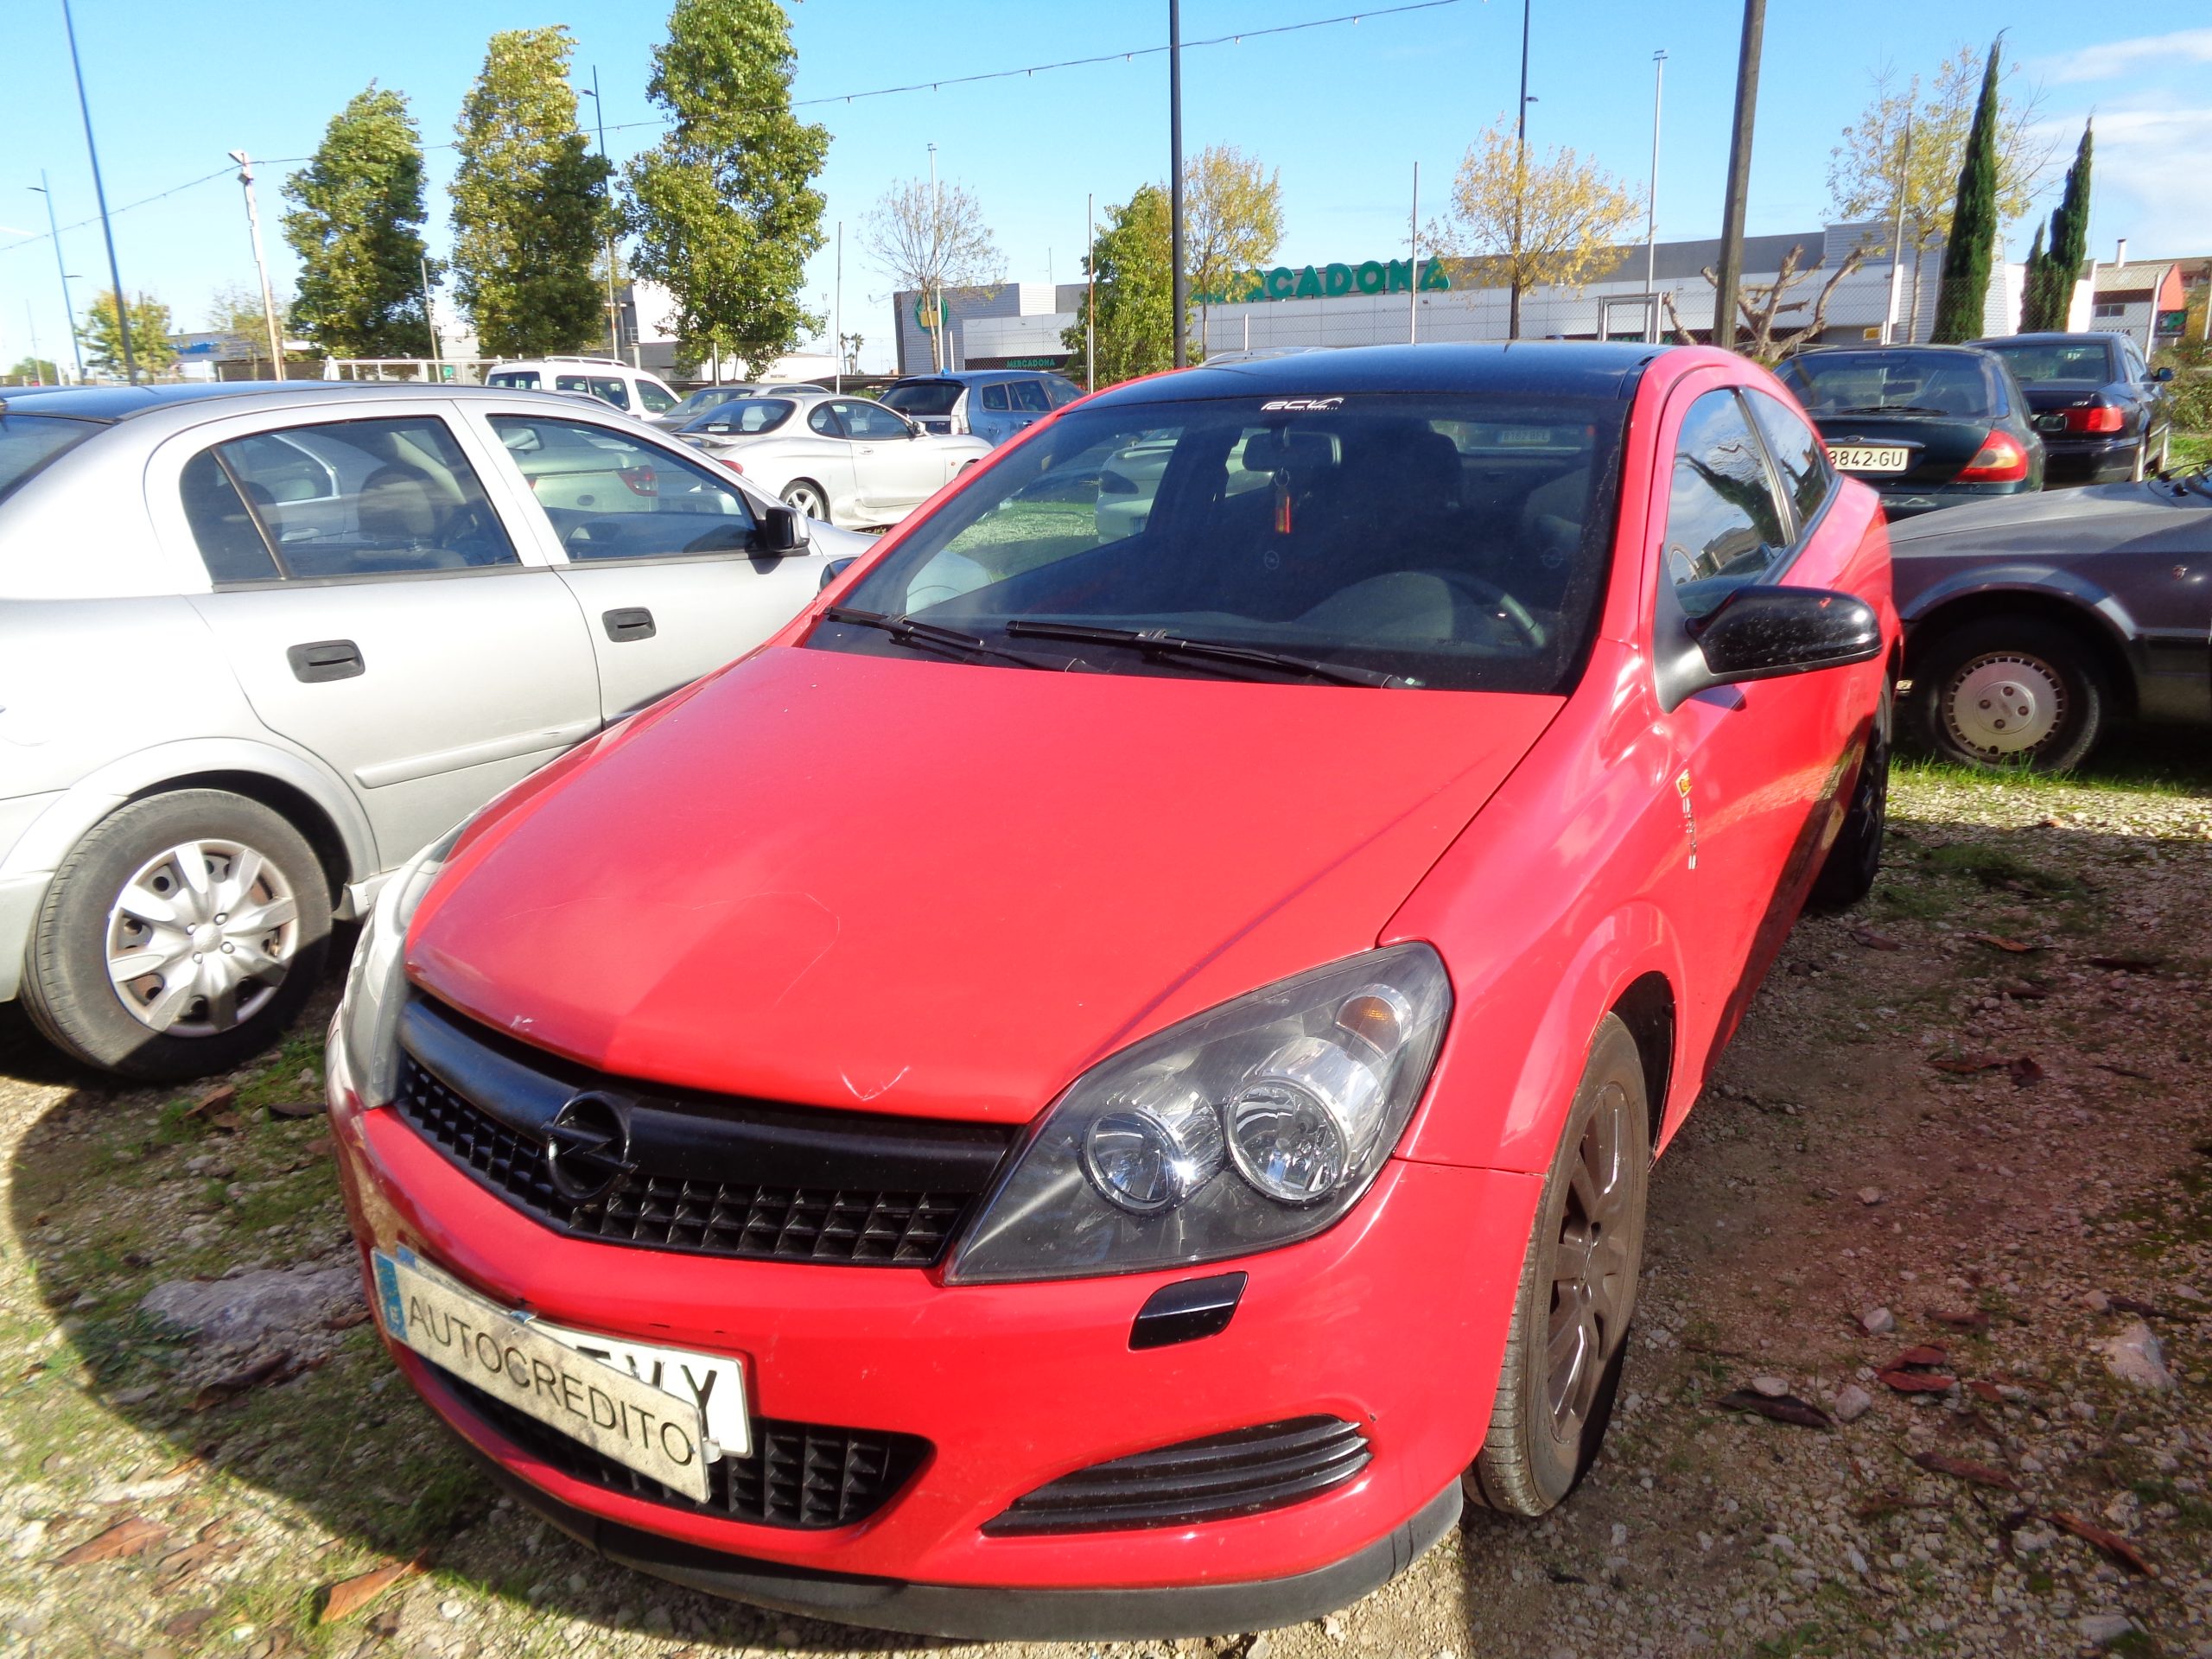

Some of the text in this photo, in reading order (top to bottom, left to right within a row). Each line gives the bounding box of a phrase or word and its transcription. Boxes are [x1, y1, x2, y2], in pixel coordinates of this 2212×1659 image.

[1189, 257, 1450, 304] RCADONA
[1007, 358, 1055, 367] MERCADONA
[409, 1295, 693, 1467] AUTOCREDITO
